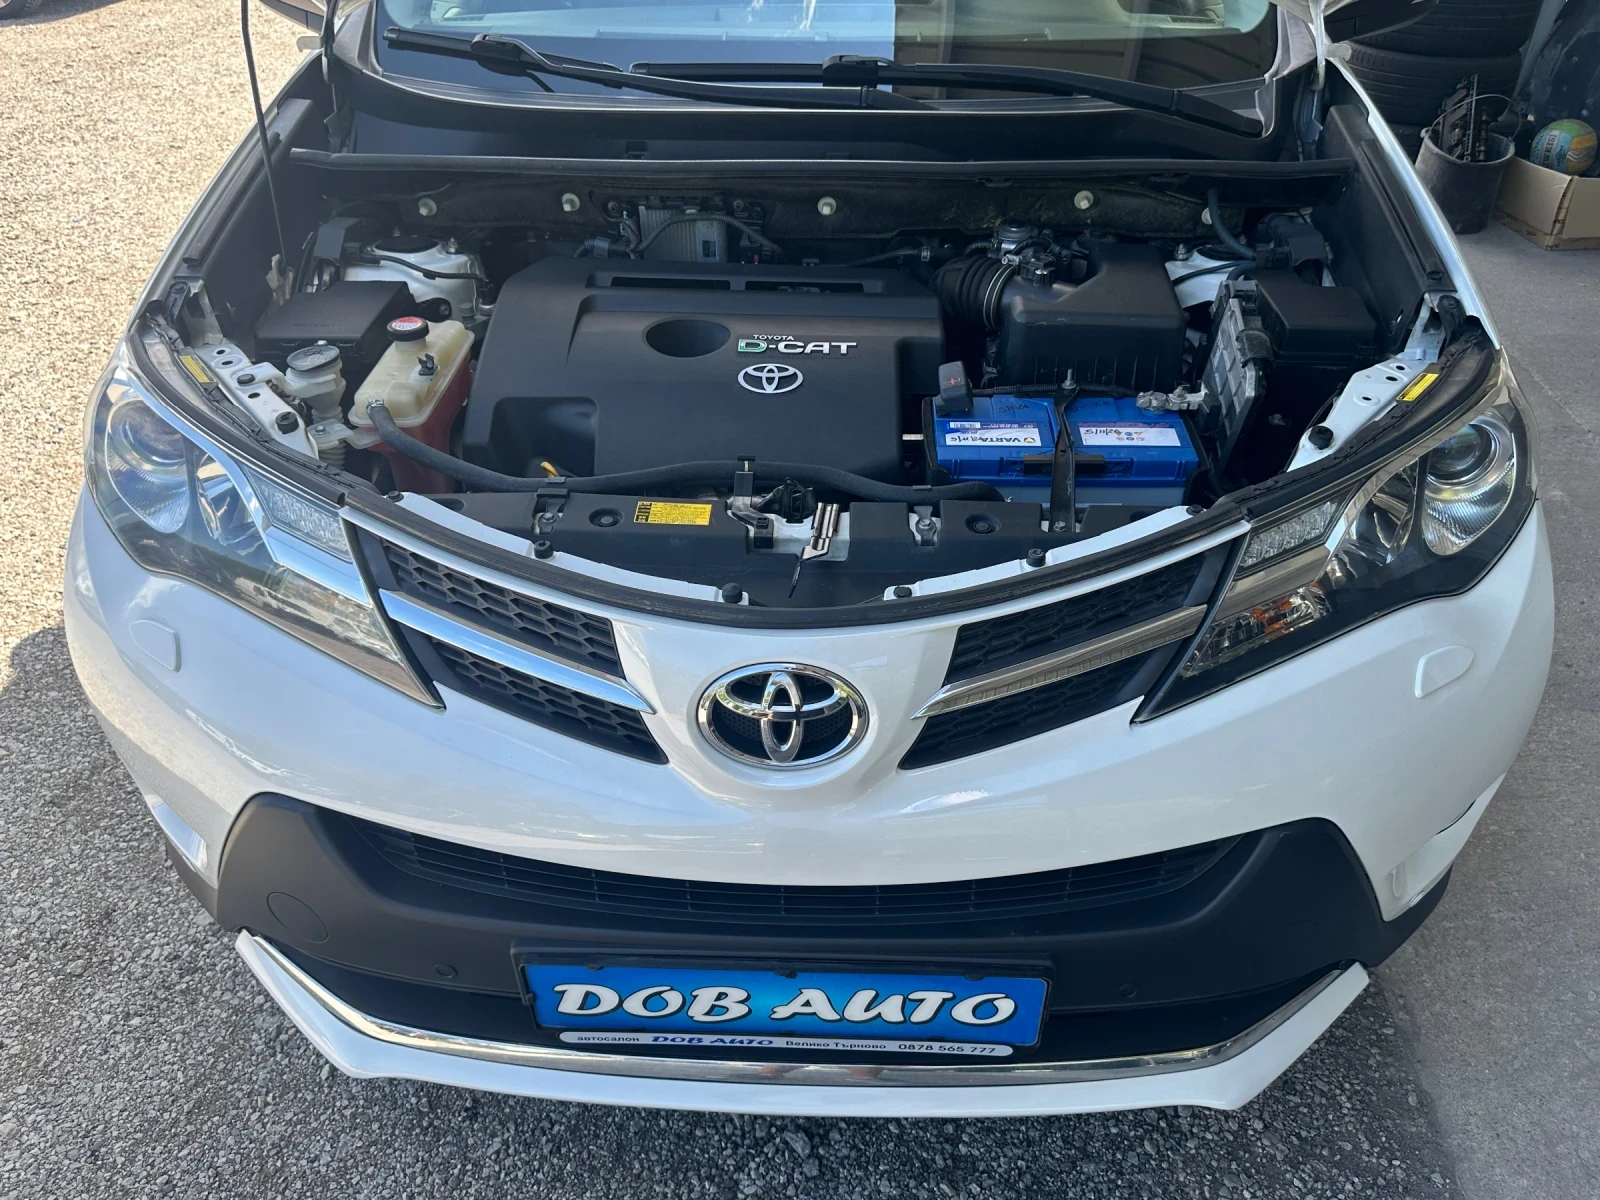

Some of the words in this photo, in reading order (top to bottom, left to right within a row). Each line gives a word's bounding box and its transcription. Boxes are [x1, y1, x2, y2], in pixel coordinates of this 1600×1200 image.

[738, 339, 857, 354] D-CAT
[553, 983, 752, 1023] DOB
[651, 1035, 704, 1044] DOB
[833, 1041, 887, 1050] Търново
[898, 1043, 934, 1051] 0878
[970, 1046, 996, 1054] 777
